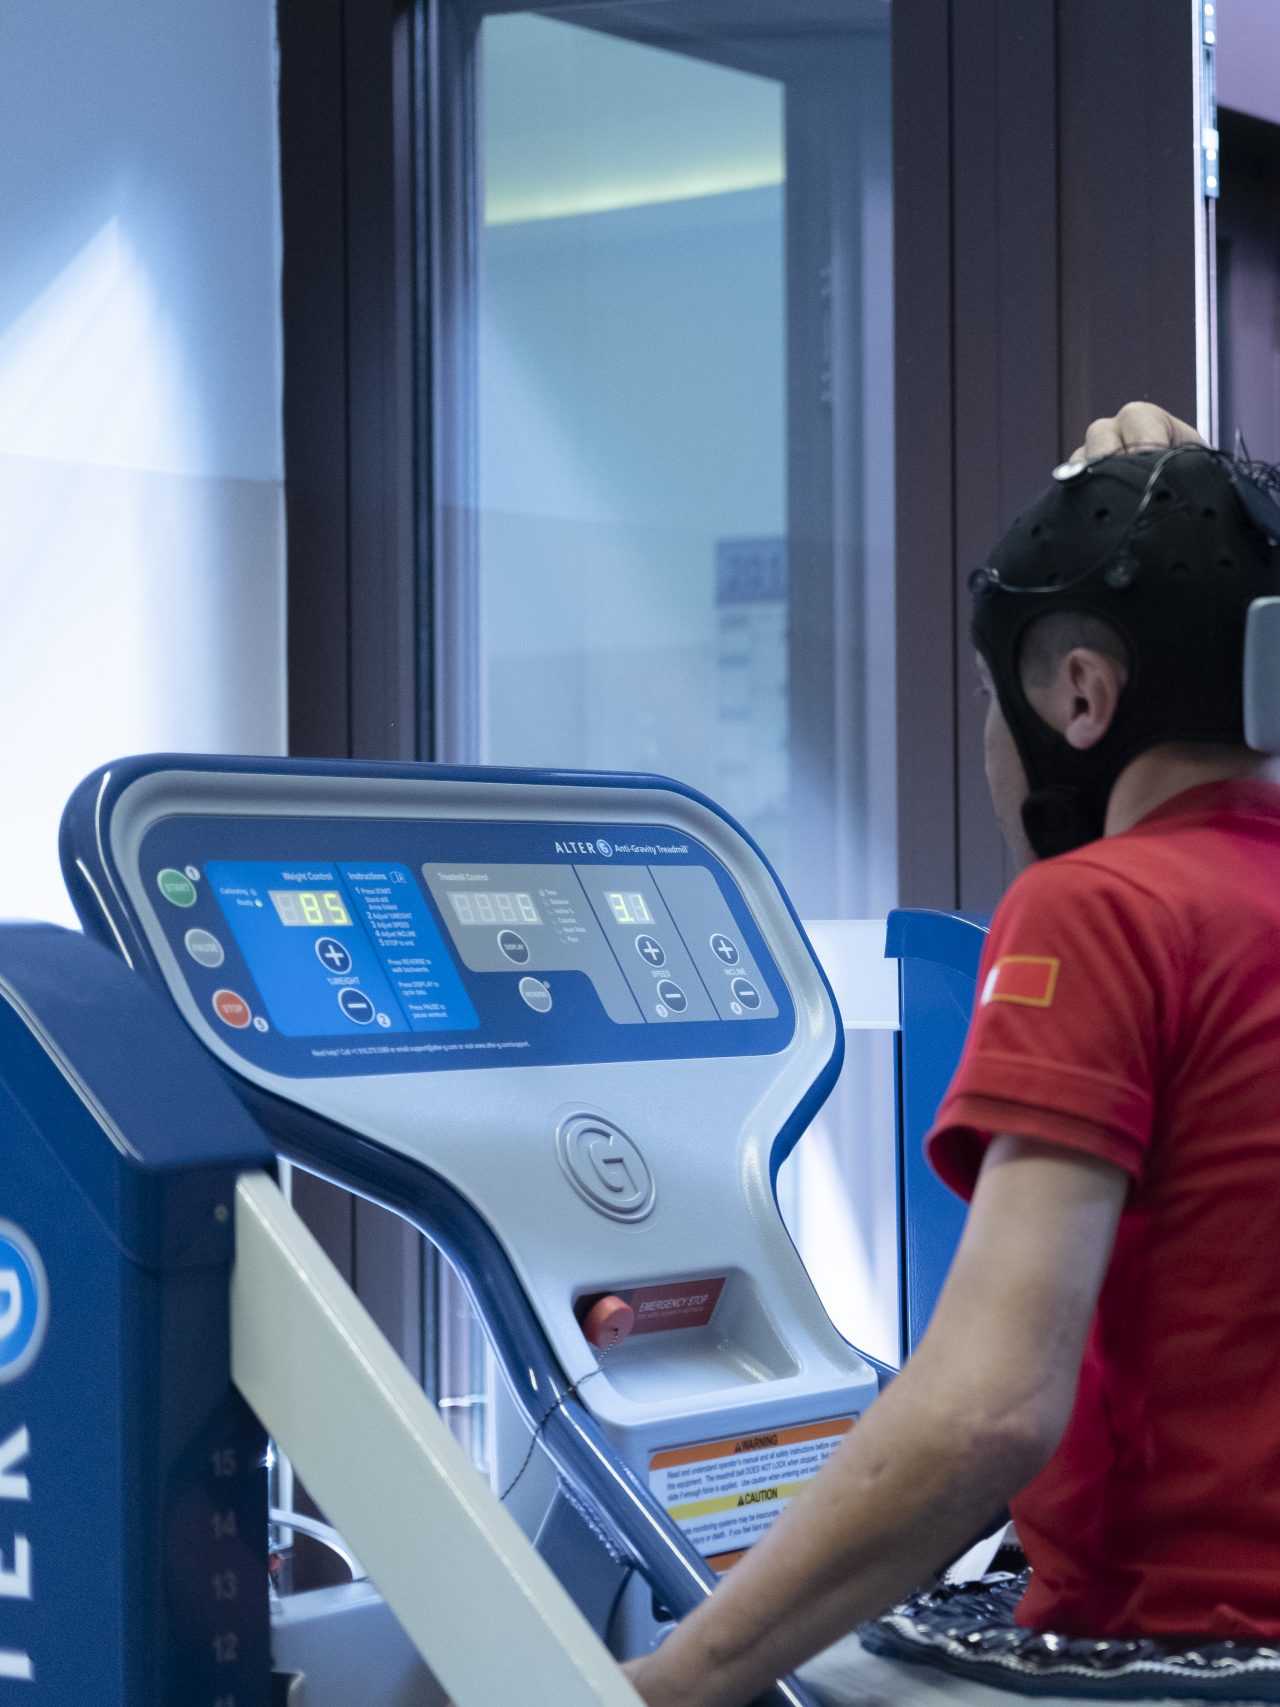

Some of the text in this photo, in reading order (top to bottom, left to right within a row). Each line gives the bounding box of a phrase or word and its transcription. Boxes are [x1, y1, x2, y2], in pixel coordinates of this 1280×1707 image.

[555, 841, 597, 854] ALTER
[615, 843, 657, 855] Anti-Gravity
[281, 871, 334, 883] Weight Control
[347, 871, 388, 881] Instructions
[437, 872, 489, 881] Treadmill Control
[299, 893, 348, 924] 85
[651, 970, 671, 978] SPEED
[724, 967, 747, 976] INCLINE
[638, 1294, 709, 1313] EMERGENCY STOP
[741, 1434, 778, 1450] WARNING
[744, 1465, 760, 1475] DOES
[761, 1463, 771, 1471] NOT
[772, 1460, 786, 1470] LOCK
[744, 1487, 778, 1505] CAUTION
